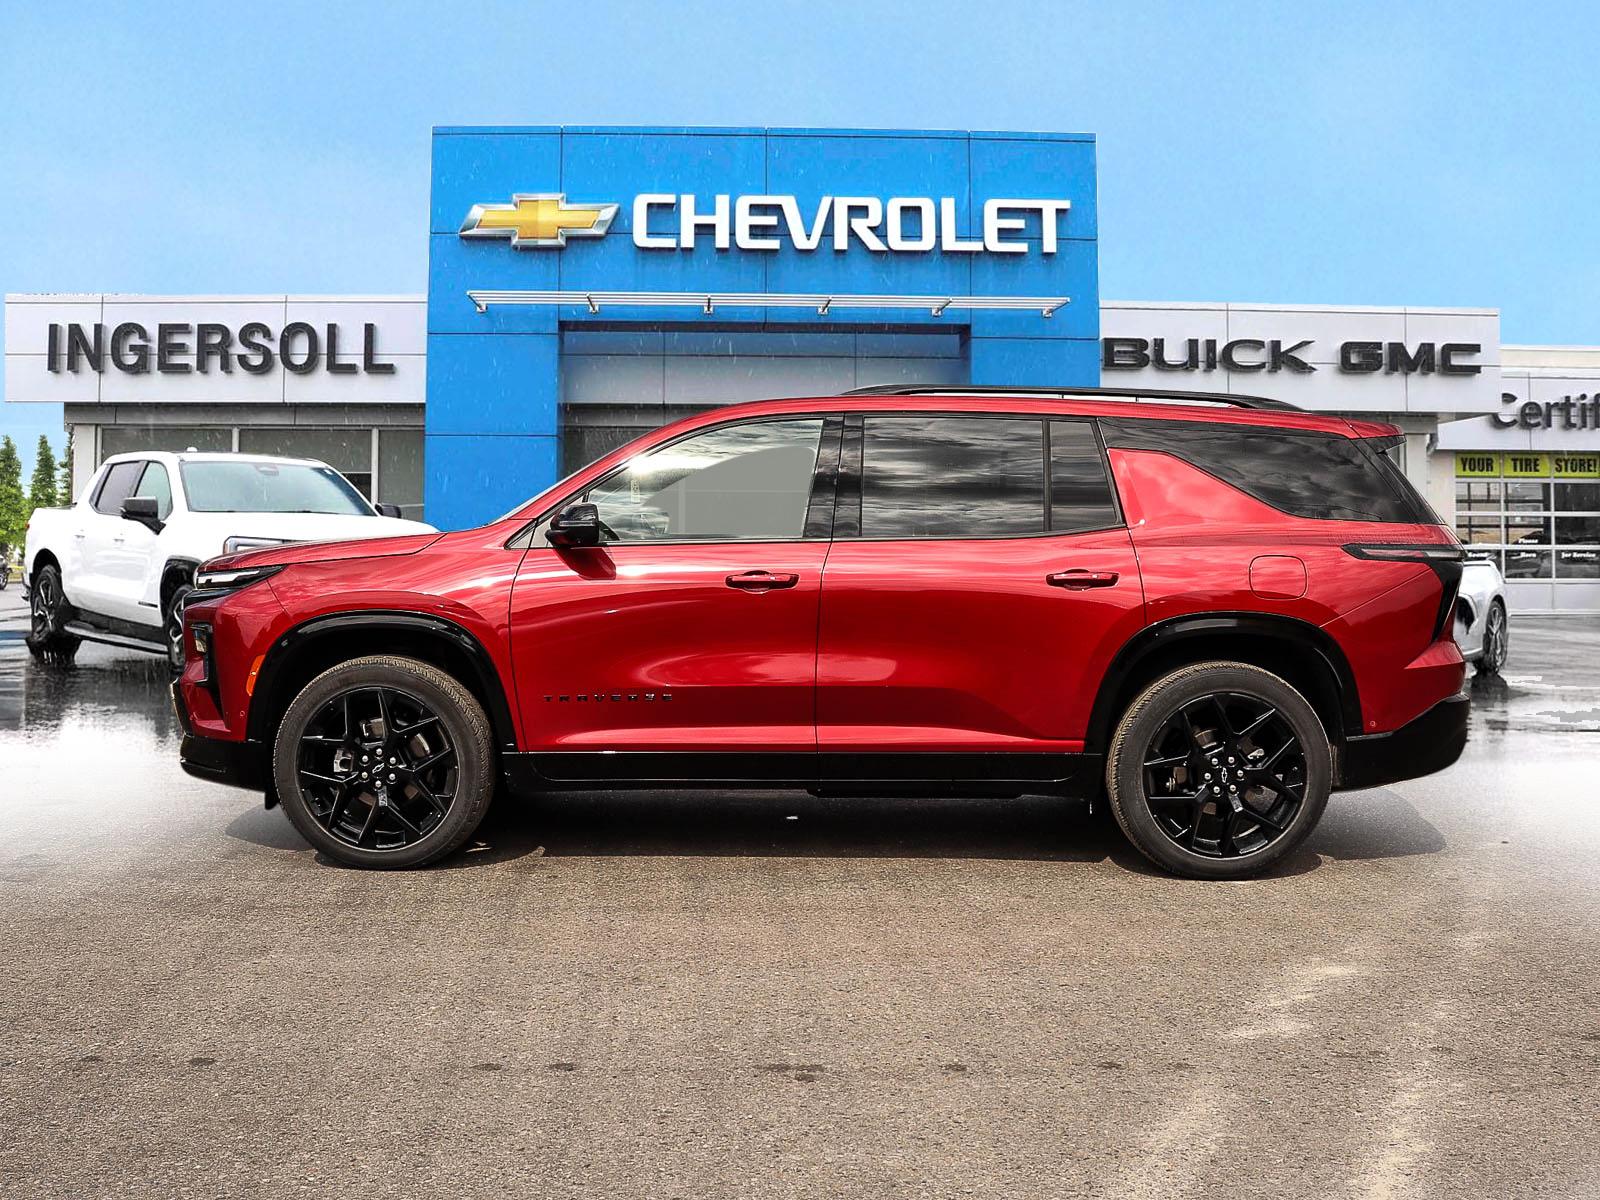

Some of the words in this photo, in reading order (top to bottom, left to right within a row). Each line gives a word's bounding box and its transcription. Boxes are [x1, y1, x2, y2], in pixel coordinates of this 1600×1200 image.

[632, 193, 1071, 254] CHEVROLET
[47, 322, 396, 375] INGERSOLL
[1102, 337, 1317, 372] BUICK
[1340, 341, 1482, 375] GMC
[1460, 457, 1494, 472] YOUR
[1511, 458, 1540, 473] TIRE
[1554, 458, 1597, 473] STORE!
[543, 694, 673, 702] TRAVERSE
